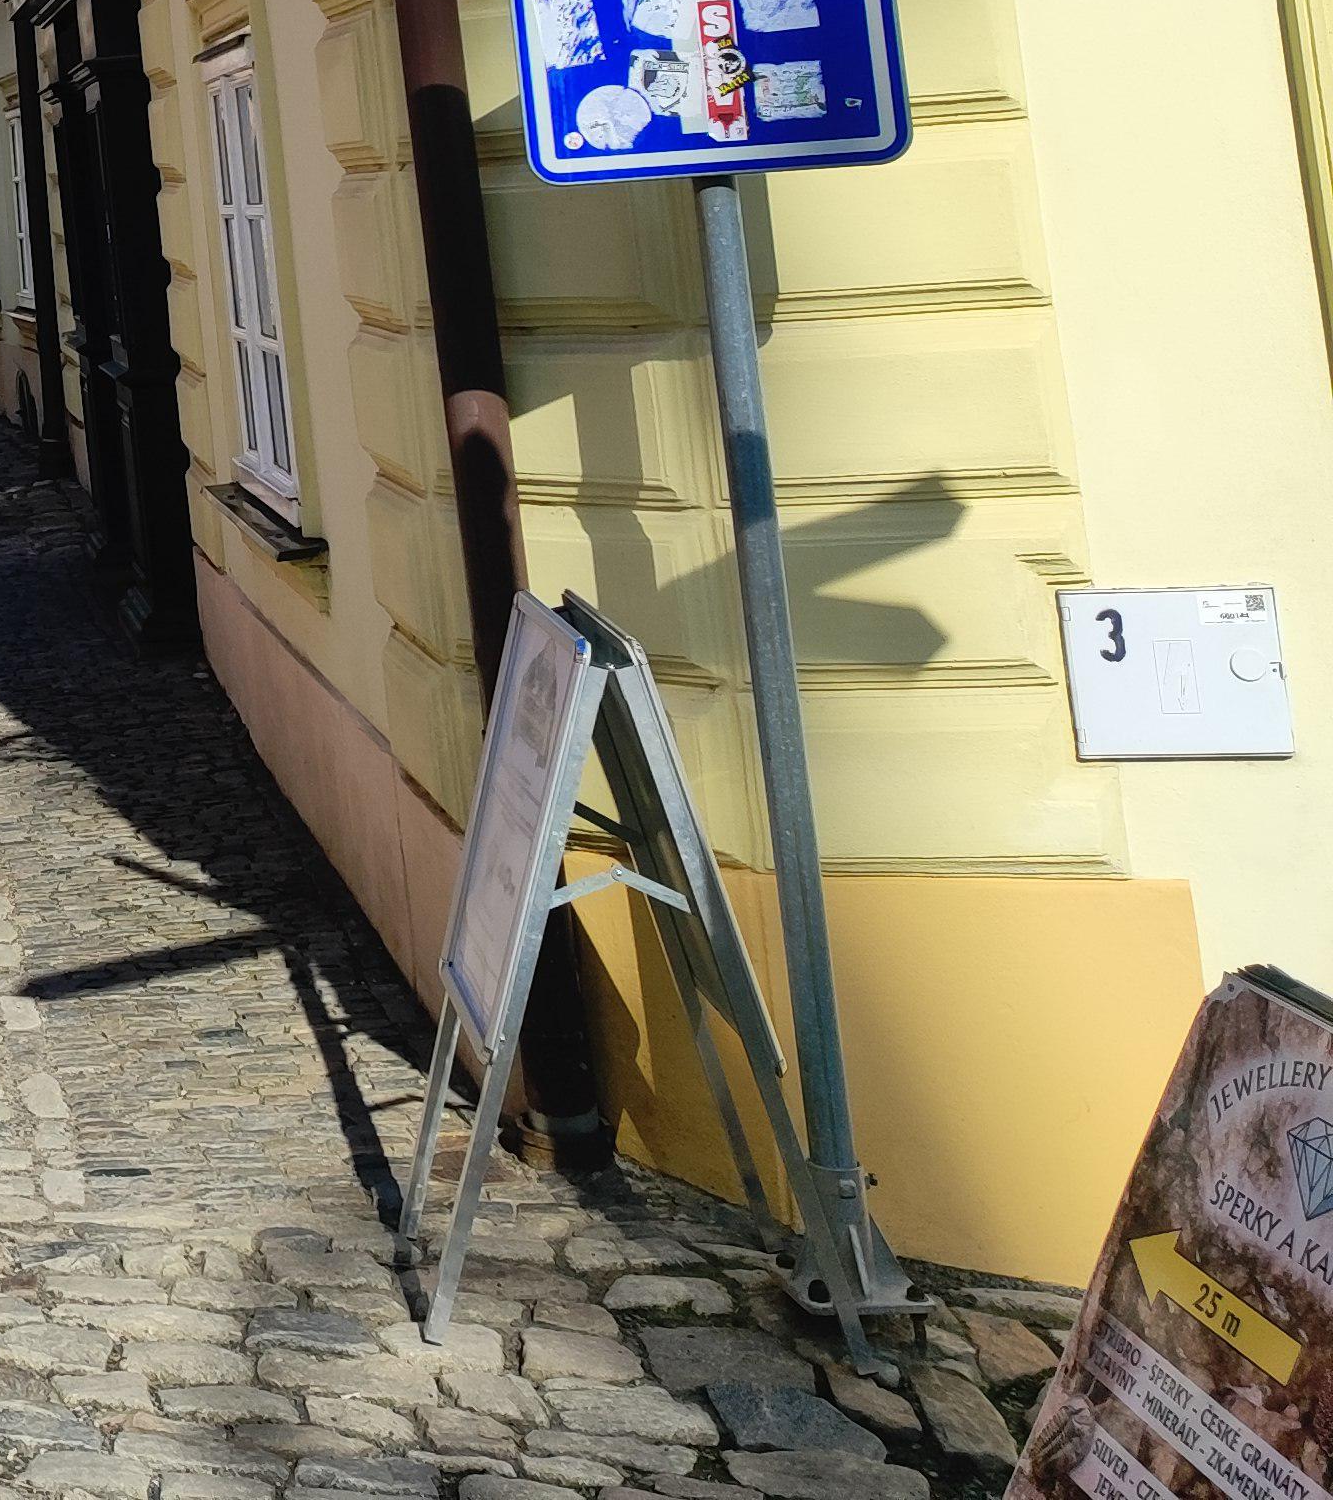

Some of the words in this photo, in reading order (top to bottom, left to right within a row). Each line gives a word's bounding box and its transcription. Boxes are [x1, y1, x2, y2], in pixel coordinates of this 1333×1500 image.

[1096, 609, 1126, 662] 3
[1210, 1060, 1333, 1124] JEWELLERY
[1210, 1172, 1282, 1242] ŠPERKY
[1276, 1229, 1296, 1259] A
[1298, 1238, 1333, 1286] KA
[1192, 1283, 1223, 1319] 25
[1221, 1311, 1241, 1338] m
[1141, 1390, 1200, 1454] MINERÁLY
[1148, 1358, 1194, 1410] ŠPERKY
[1200, 1404, 1242, 1452] ČESKÉ
[1093, 1438, 1128, 1482] SILVER
